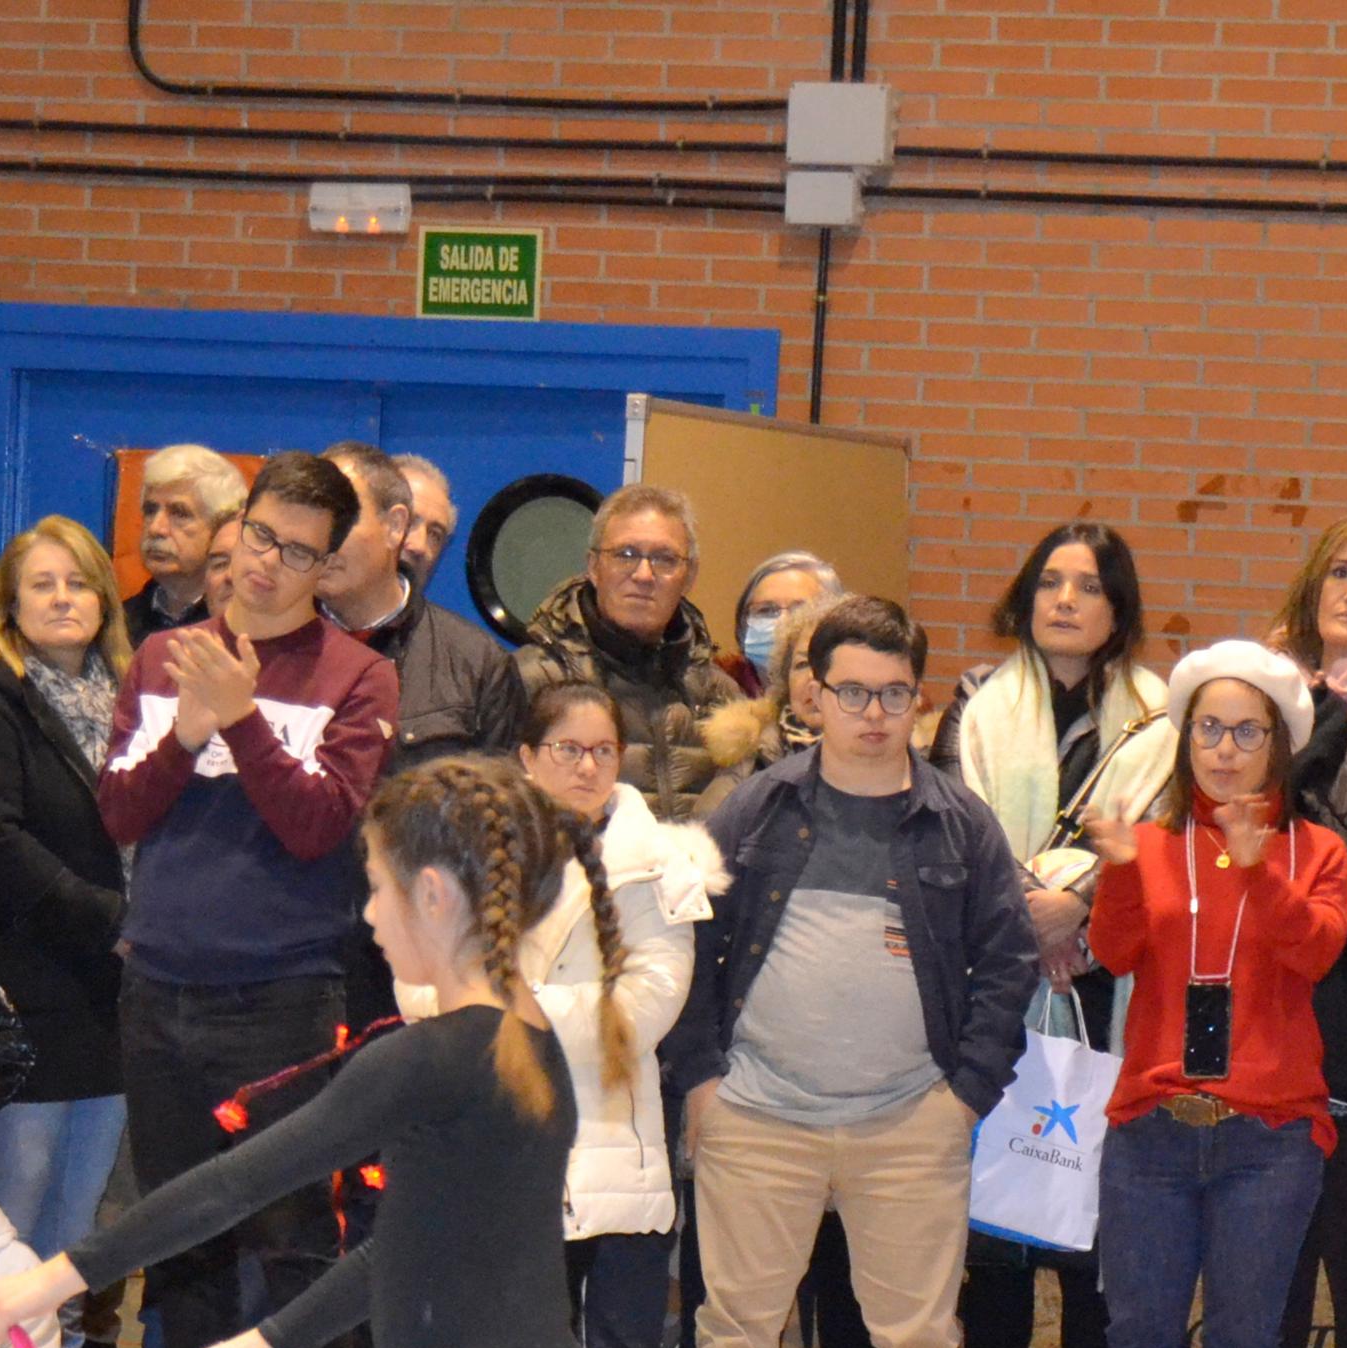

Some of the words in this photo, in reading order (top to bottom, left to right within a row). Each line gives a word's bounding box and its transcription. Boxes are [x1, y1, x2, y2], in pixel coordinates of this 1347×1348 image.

[440, 244, 494, 271] SALIDA
[498, 246, 519, 272] DE
[428, 276, 528, 305] EMERGENCIA
[1008, 1136, 1084, 1172] CaixaBank
